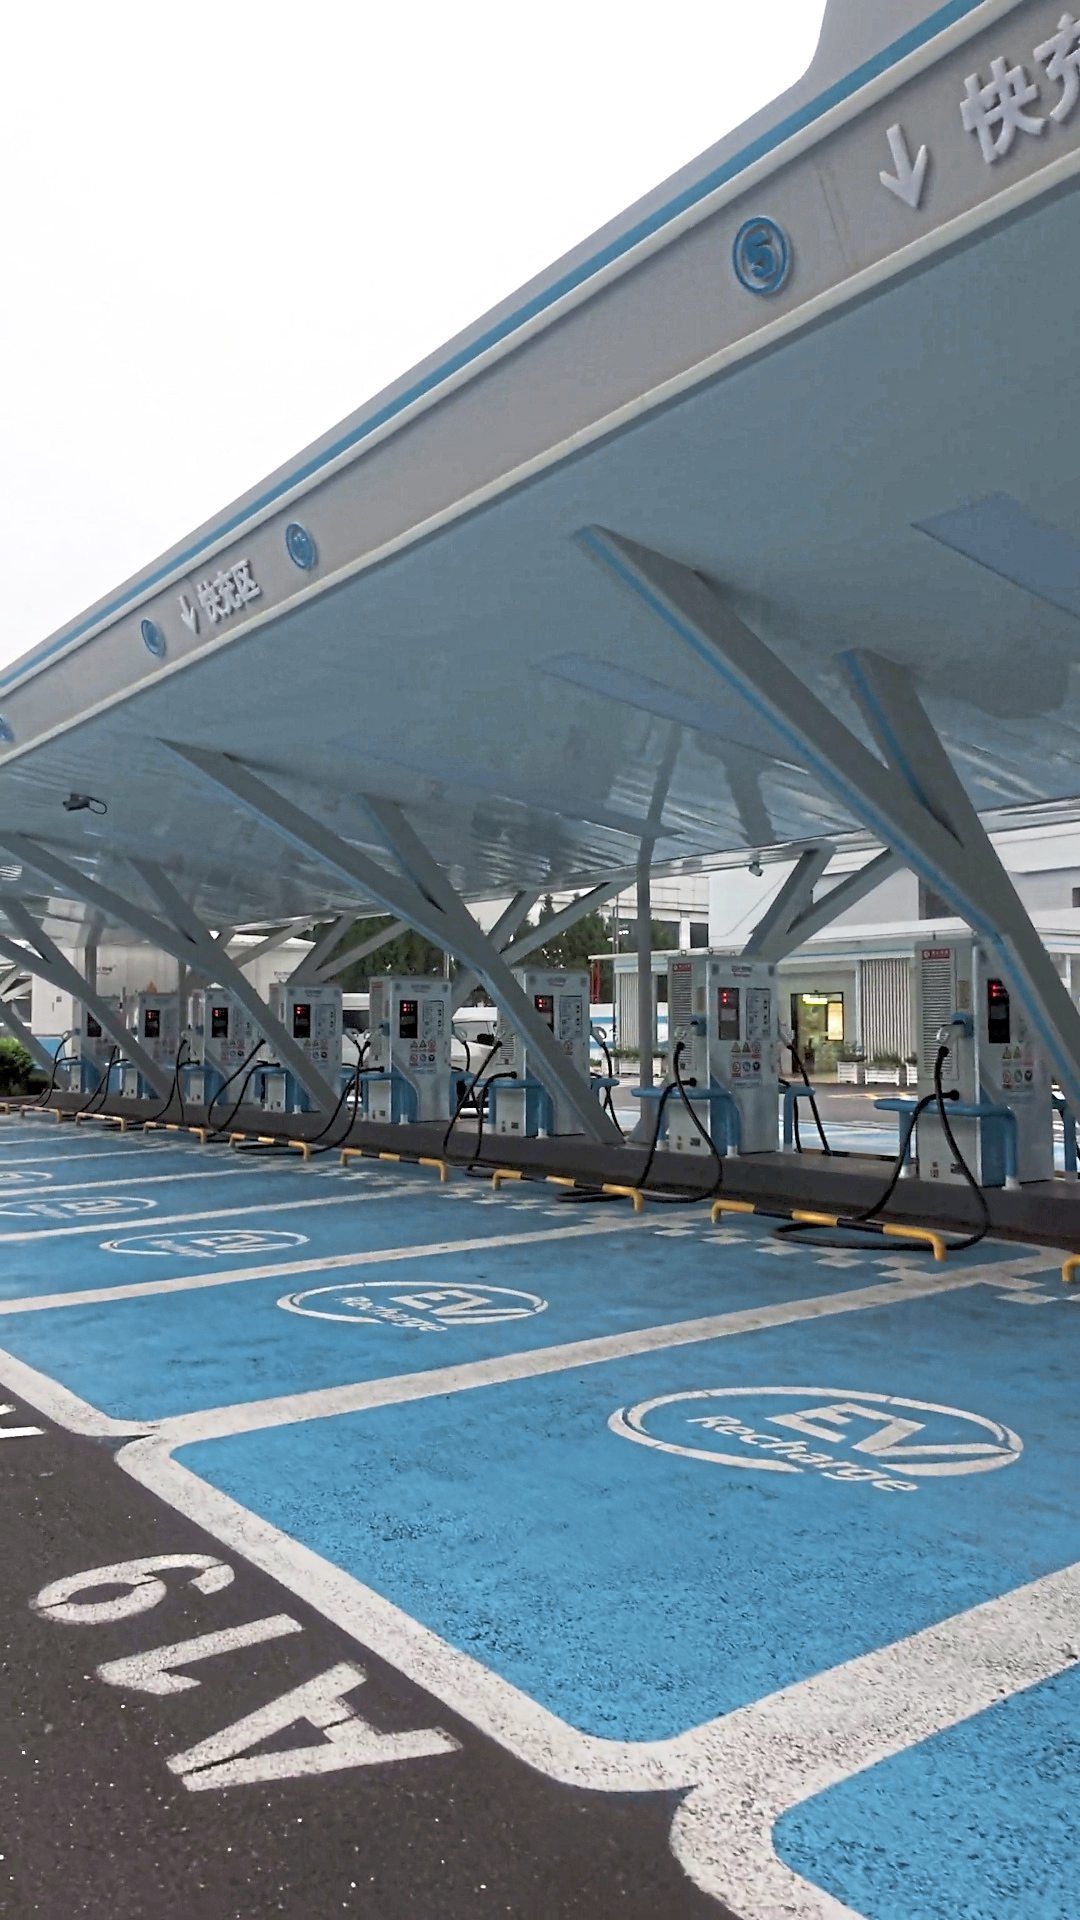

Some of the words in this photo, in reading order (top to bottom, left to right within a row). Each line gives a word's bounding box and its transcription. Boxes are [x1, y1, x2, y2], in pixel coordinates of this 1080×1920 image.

[743, 230, 776, 278] 5
[197, 560, 261, 622] 快充区
[388, 1289, 533, 1317] EV
[687, 1414, 919, 1492] Recharge
[765, 1402, 1013, 1457] EV
[33, 1553, 464, 1792] A19
